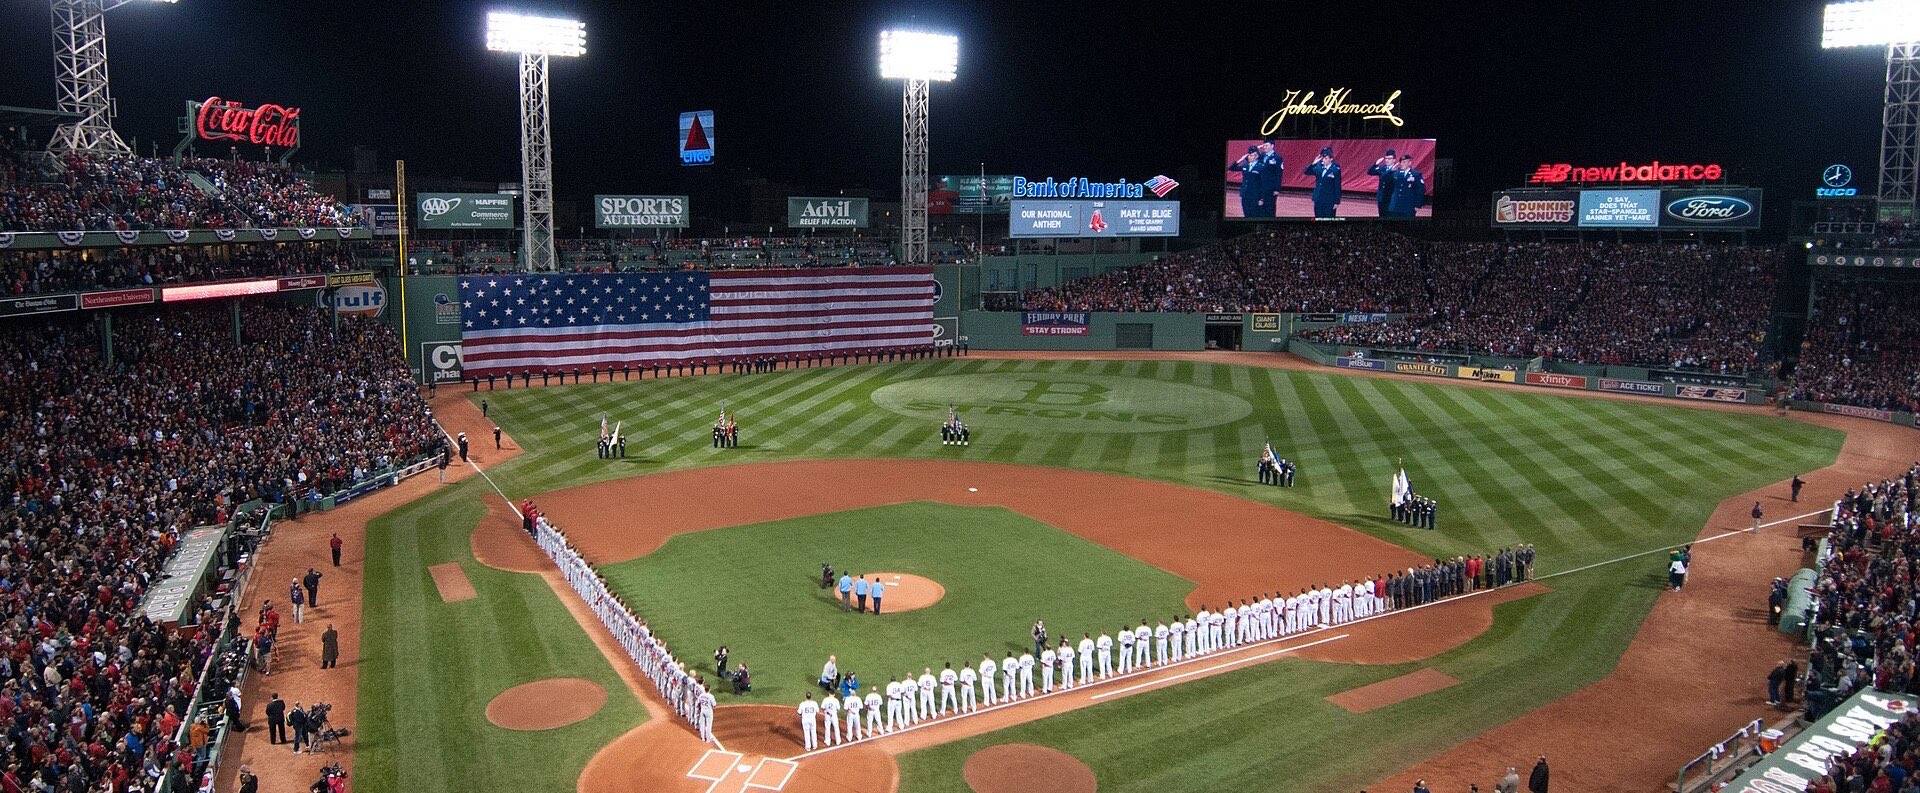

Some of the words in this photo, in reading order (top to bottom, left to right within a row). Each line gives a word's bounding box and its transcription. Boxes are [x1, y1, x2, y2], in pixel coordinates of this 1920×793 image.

[1261, 89, 1318, 136] John
[1318, 86, 1404, 127] Hancock
[683, 150, 711, 163] CITGO
[1013, 176, 1059, 198] Bank
[1060, 177, 1078, 198] of
[1077, 177, 1144, 198] America
[601, 197, 683, 215] SPORTS
[801, 200, 851, 217] Advil
[1518, 201, 1574, 211] DUNKIN'
[1682, 199, 1736, 217] Ford
[1021, 210, 1036, 218] OUR
[1037, 210, 1073, 219] NATIONAL
[1120, 209, 1142, 218] MARY
[1143, 209, 1151, 218] J.
[1151, 209, 1173, 218] BLIGE
[1518, 211, 1571, 221] DONUTS
[602, 215, 682, 226] AUTHORITY
[1032, 220, 1061, 229] ANTHEM
[1027, 312, 1061, 324] FENWAY
[1063, 312, 1086, 325] PARK
[1539, 374, 1572, 387] xfinity
[1620, 382, 1636, 390] ACE
[1638, 383, 1661, 392] TICKET
